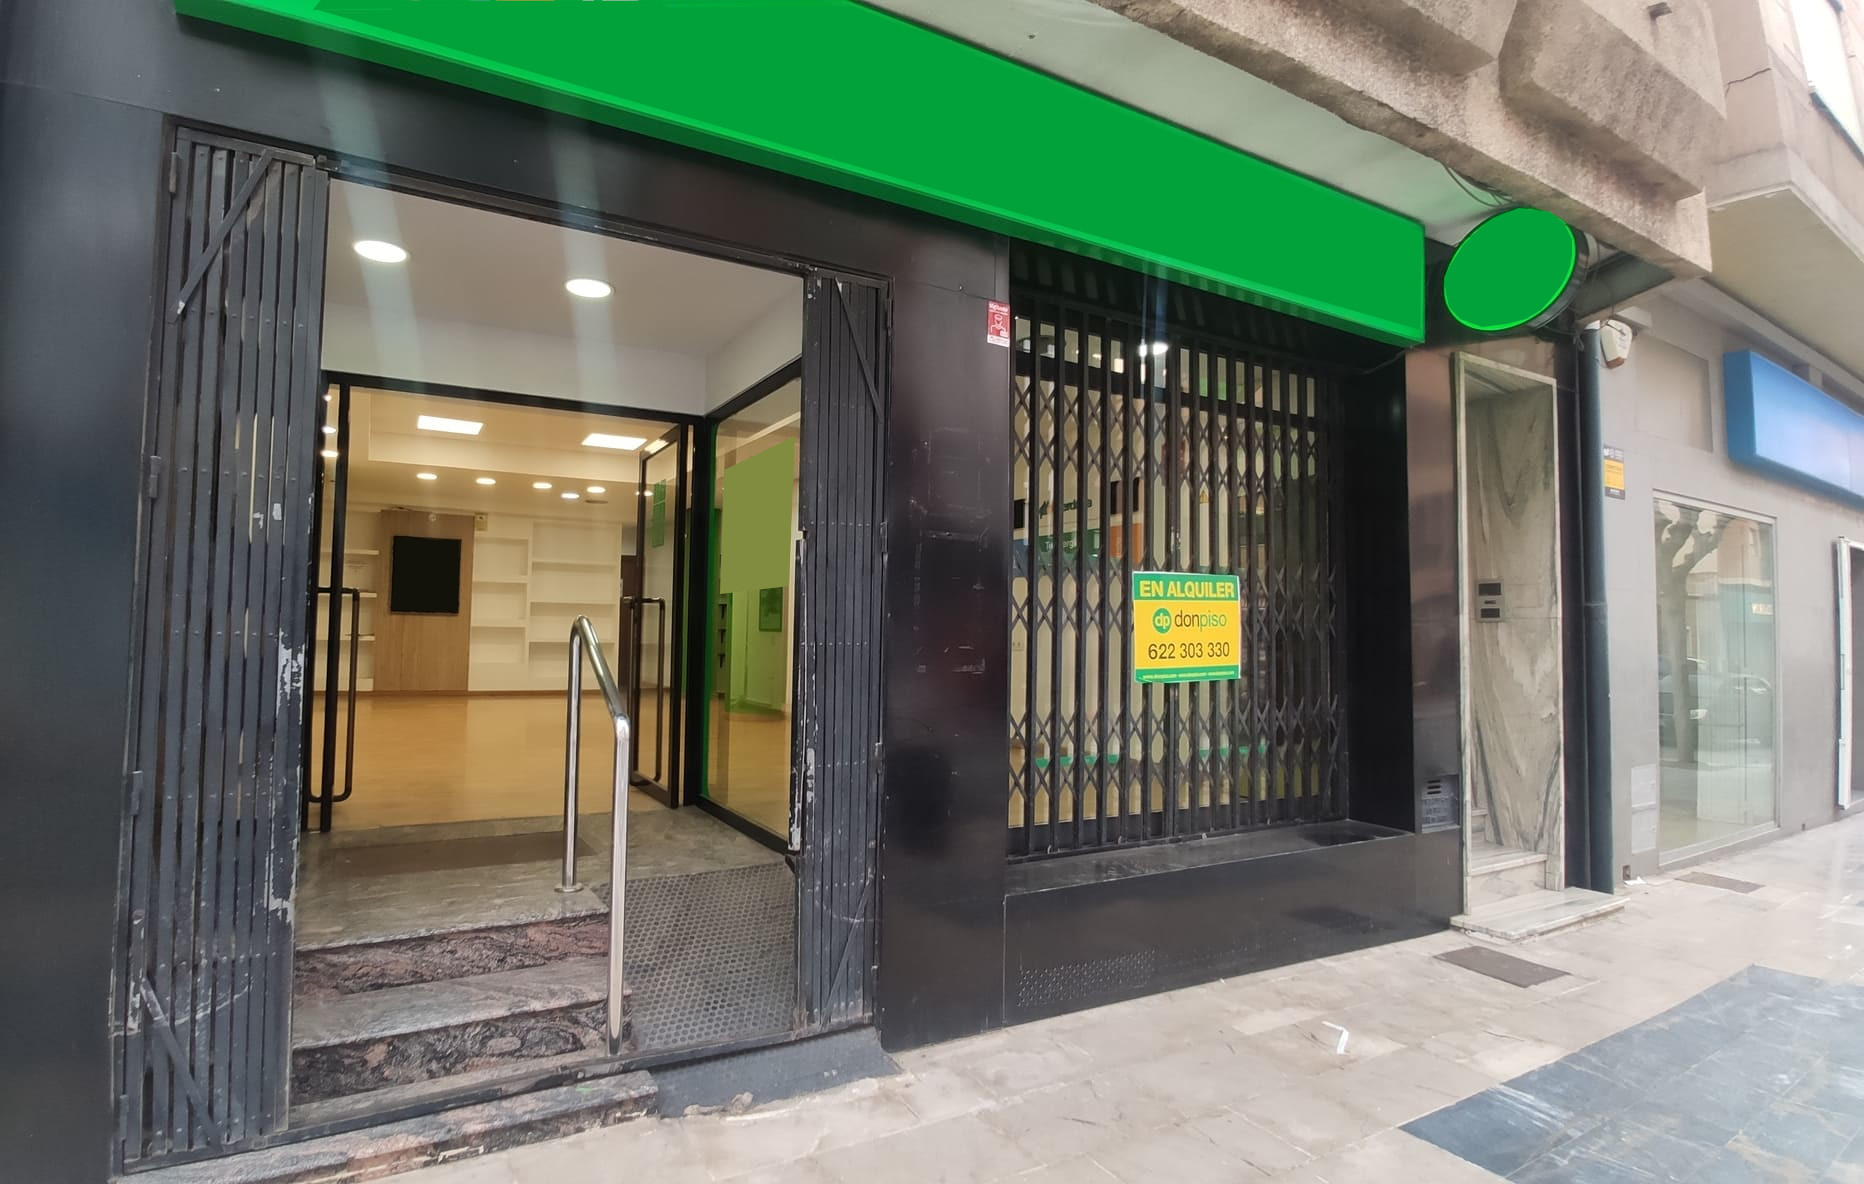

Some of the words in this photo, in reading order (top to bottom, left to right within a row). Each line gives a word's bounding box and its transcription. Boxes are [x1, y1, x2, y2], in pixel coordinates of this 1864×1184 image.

[1139, 580, 1164, 598] EN
[1166, 580, 1235, 598] ALQUILER
[1174, 609, 1227, 632] donpiso
[1148, 643, 1176, 660] 622
[1179, 642, 1204, 659] 303
[1207, 641, 1230, 658] 330
